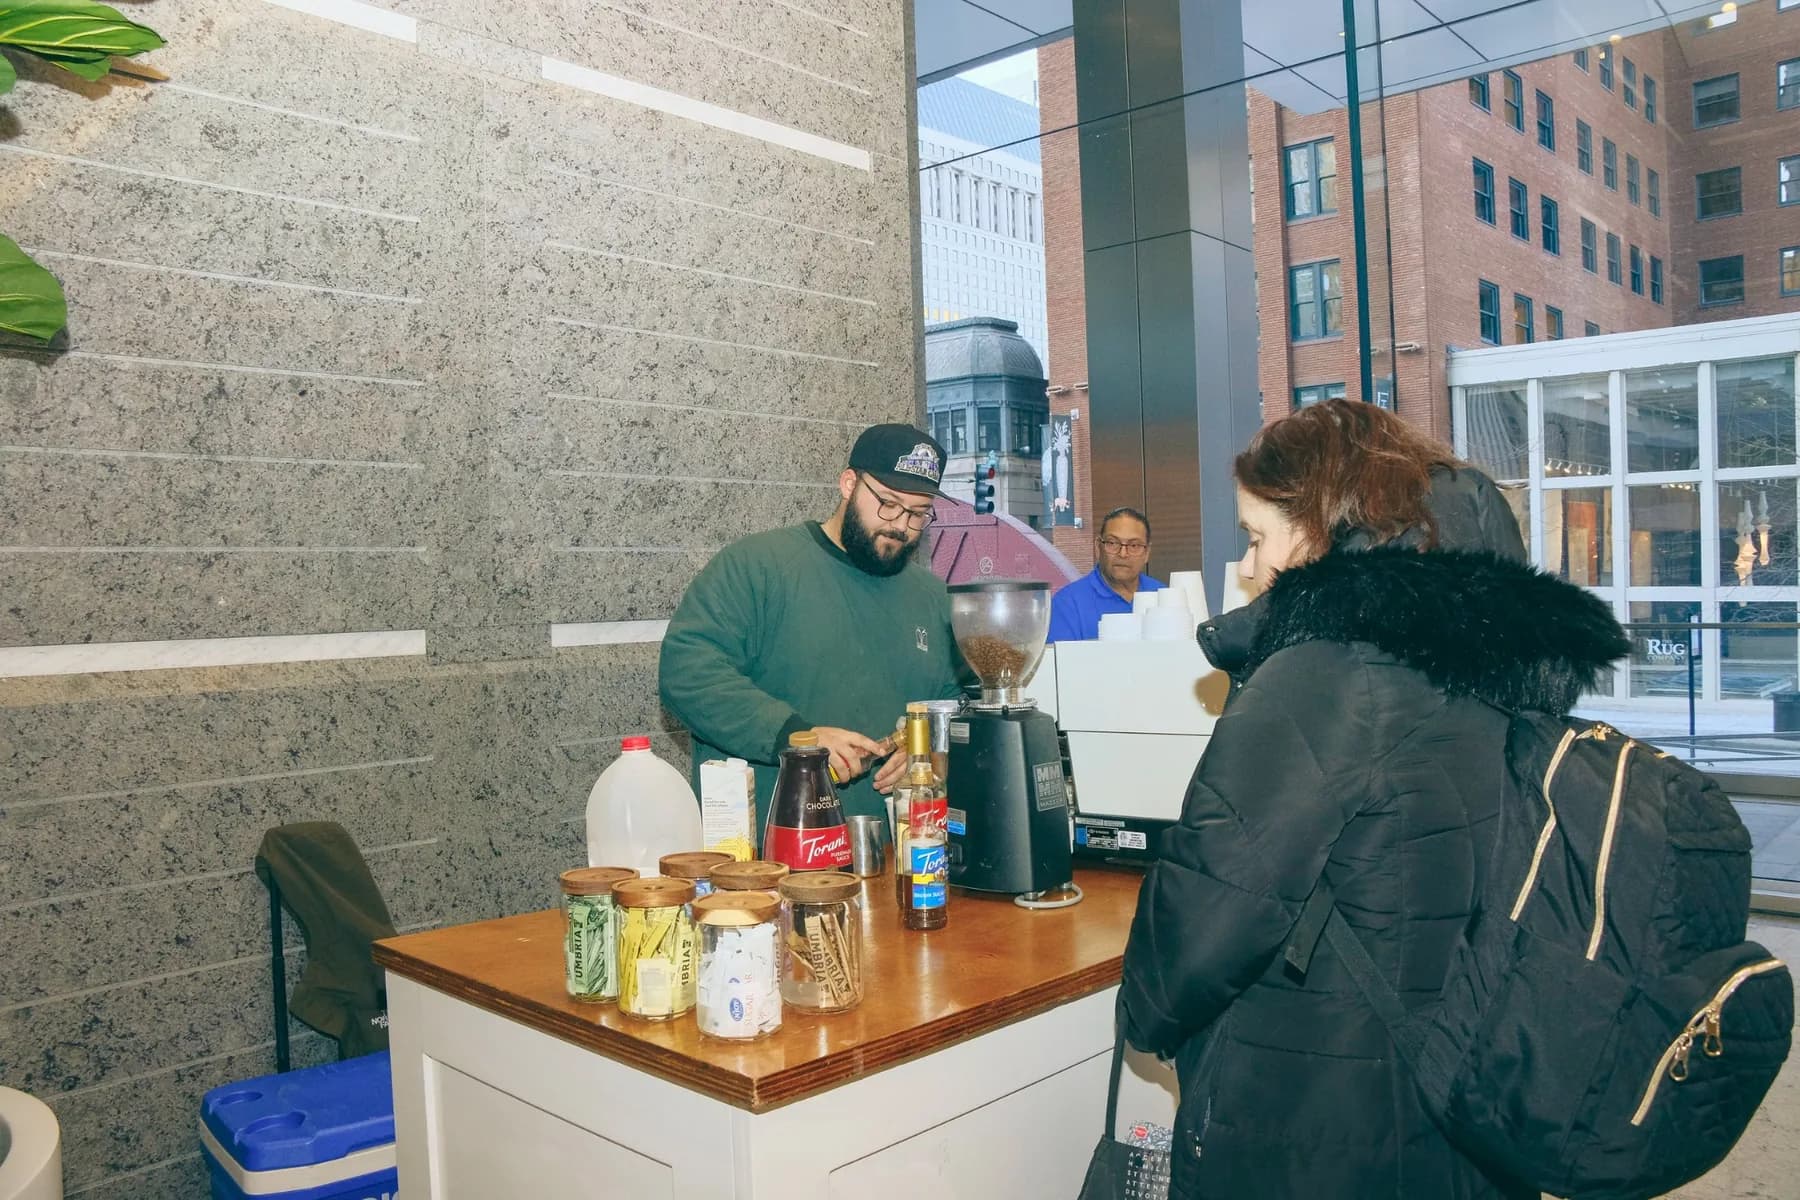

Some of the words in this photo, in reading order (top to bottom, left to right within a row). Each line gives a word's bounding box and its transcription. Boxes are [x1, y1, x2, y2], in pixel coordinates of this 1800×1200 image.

[1647, 638, 1685, 655] RUG
[802, 831, 845, 864] Torani
[574, 931, 583, 978] UMBRIA
[681, 949, 691, 986] BRIA
[809, 933, 826, 983] UMBRIA
[824, 951, 845, 987] BRIA
